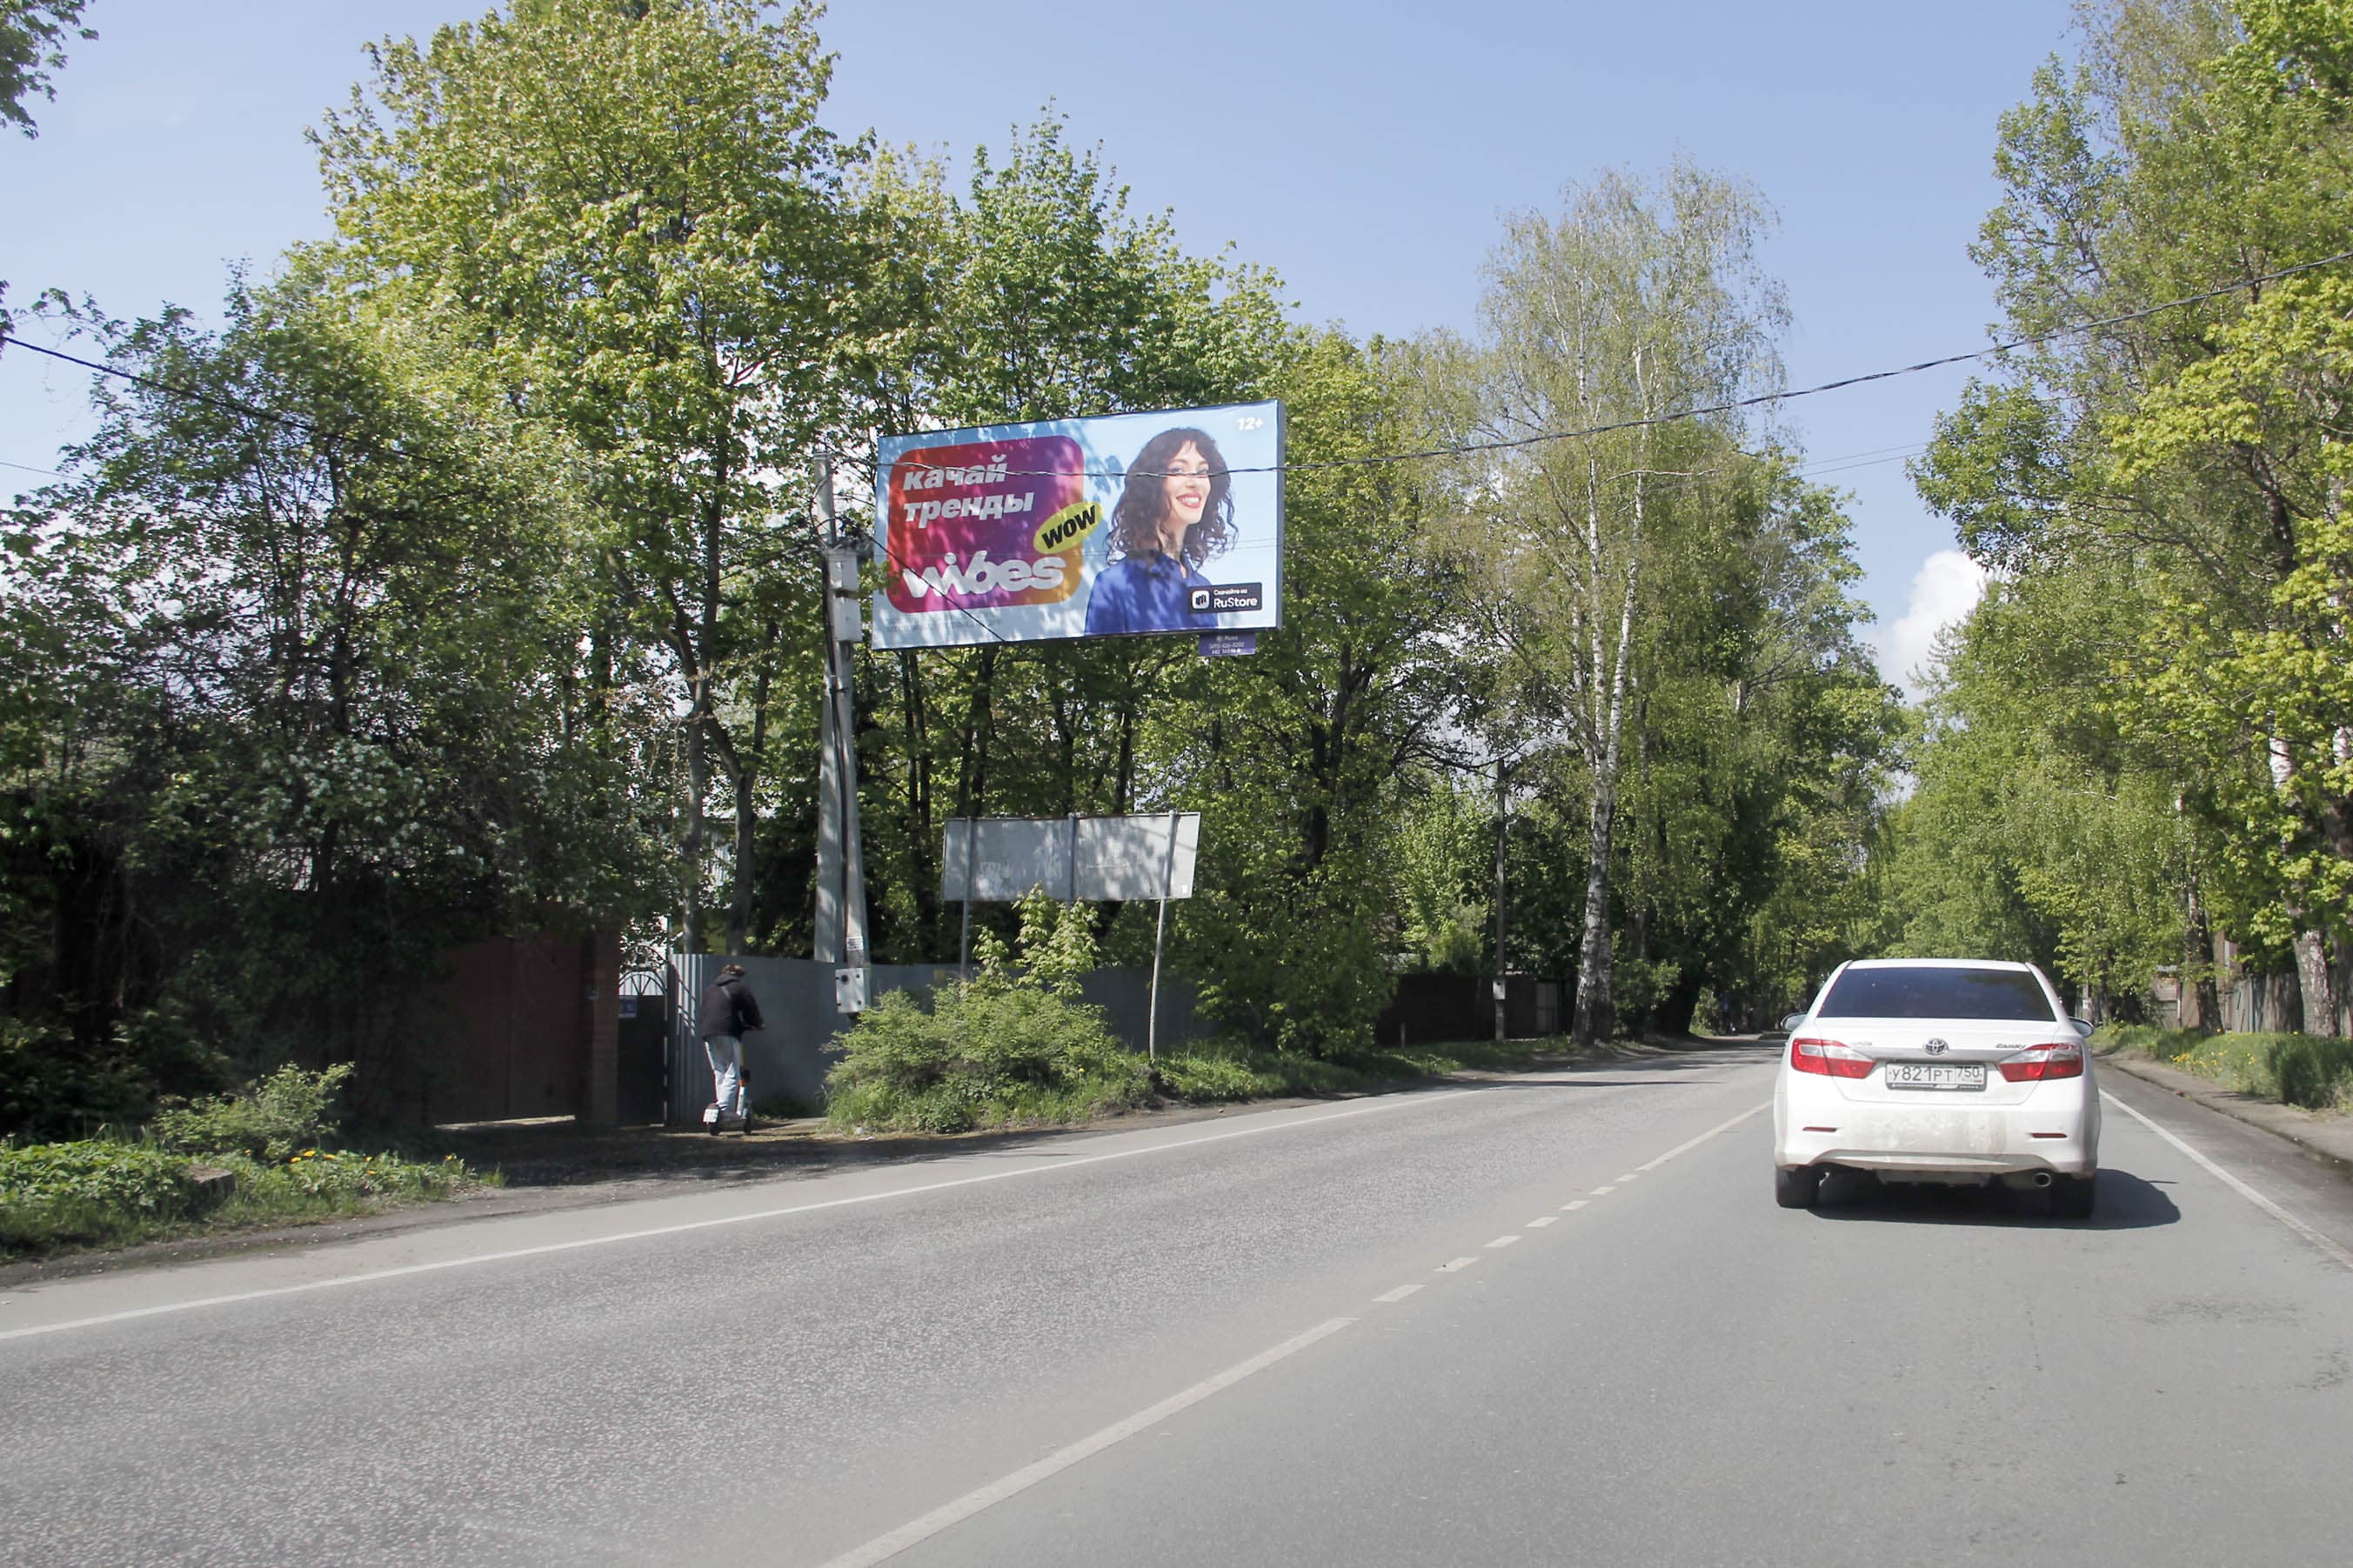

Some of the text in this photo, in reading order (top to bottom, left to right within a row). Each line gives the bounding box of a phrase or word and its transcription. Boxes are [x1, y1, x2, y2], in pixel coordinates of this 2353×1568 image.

[1239, 417, 1264, 430] 12+
[903, 454, 1007, 491] качай
[903, 492, 1035, 529] тренды
[1213, 597, 1258, 608] RuStore
[1955, 1065, 1980, 1078] 750
